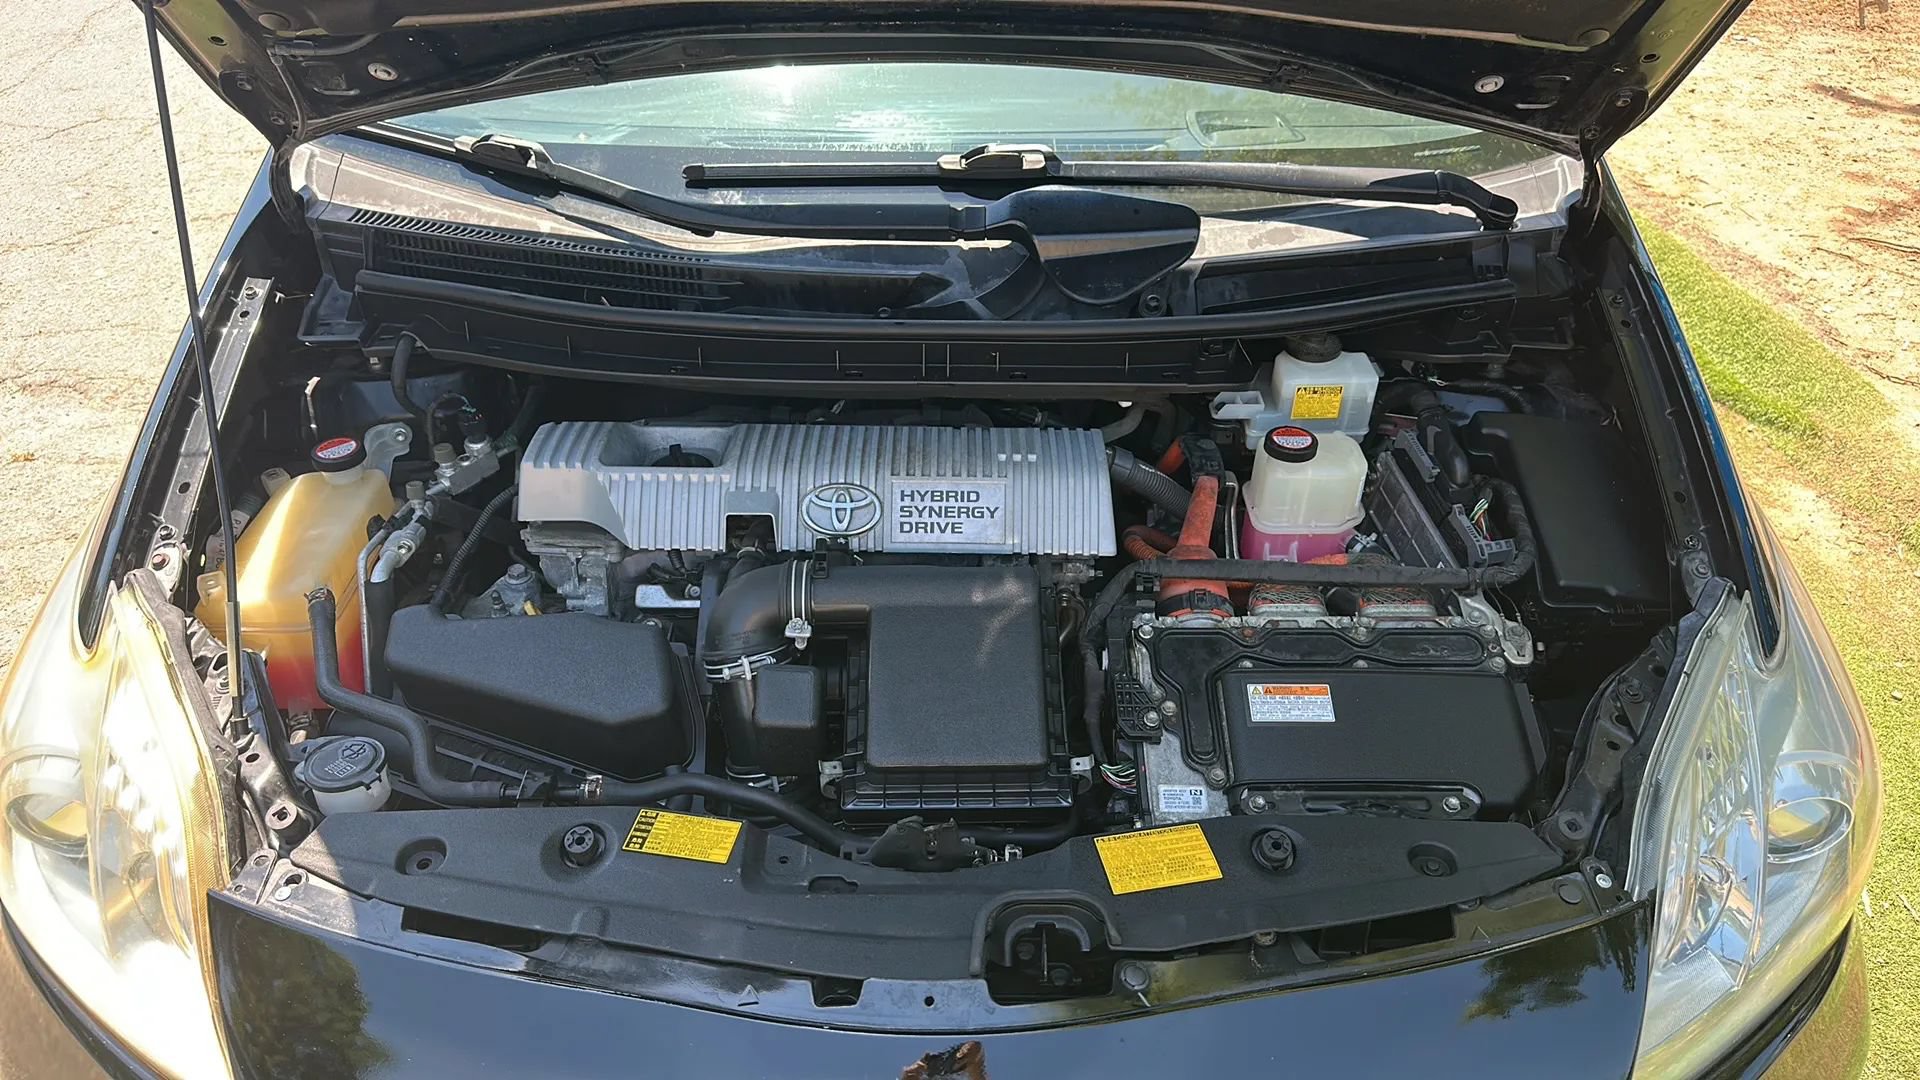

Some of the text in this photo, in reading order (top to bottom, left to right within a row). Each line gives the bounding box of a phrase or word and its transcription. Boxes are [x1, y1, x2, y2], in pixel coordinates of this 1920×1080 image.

[900, 490, 980, 503] HYBRID
[899, 505, 1000, 519] SYNERGY
[899, 521, 964, 534] DRIVE
